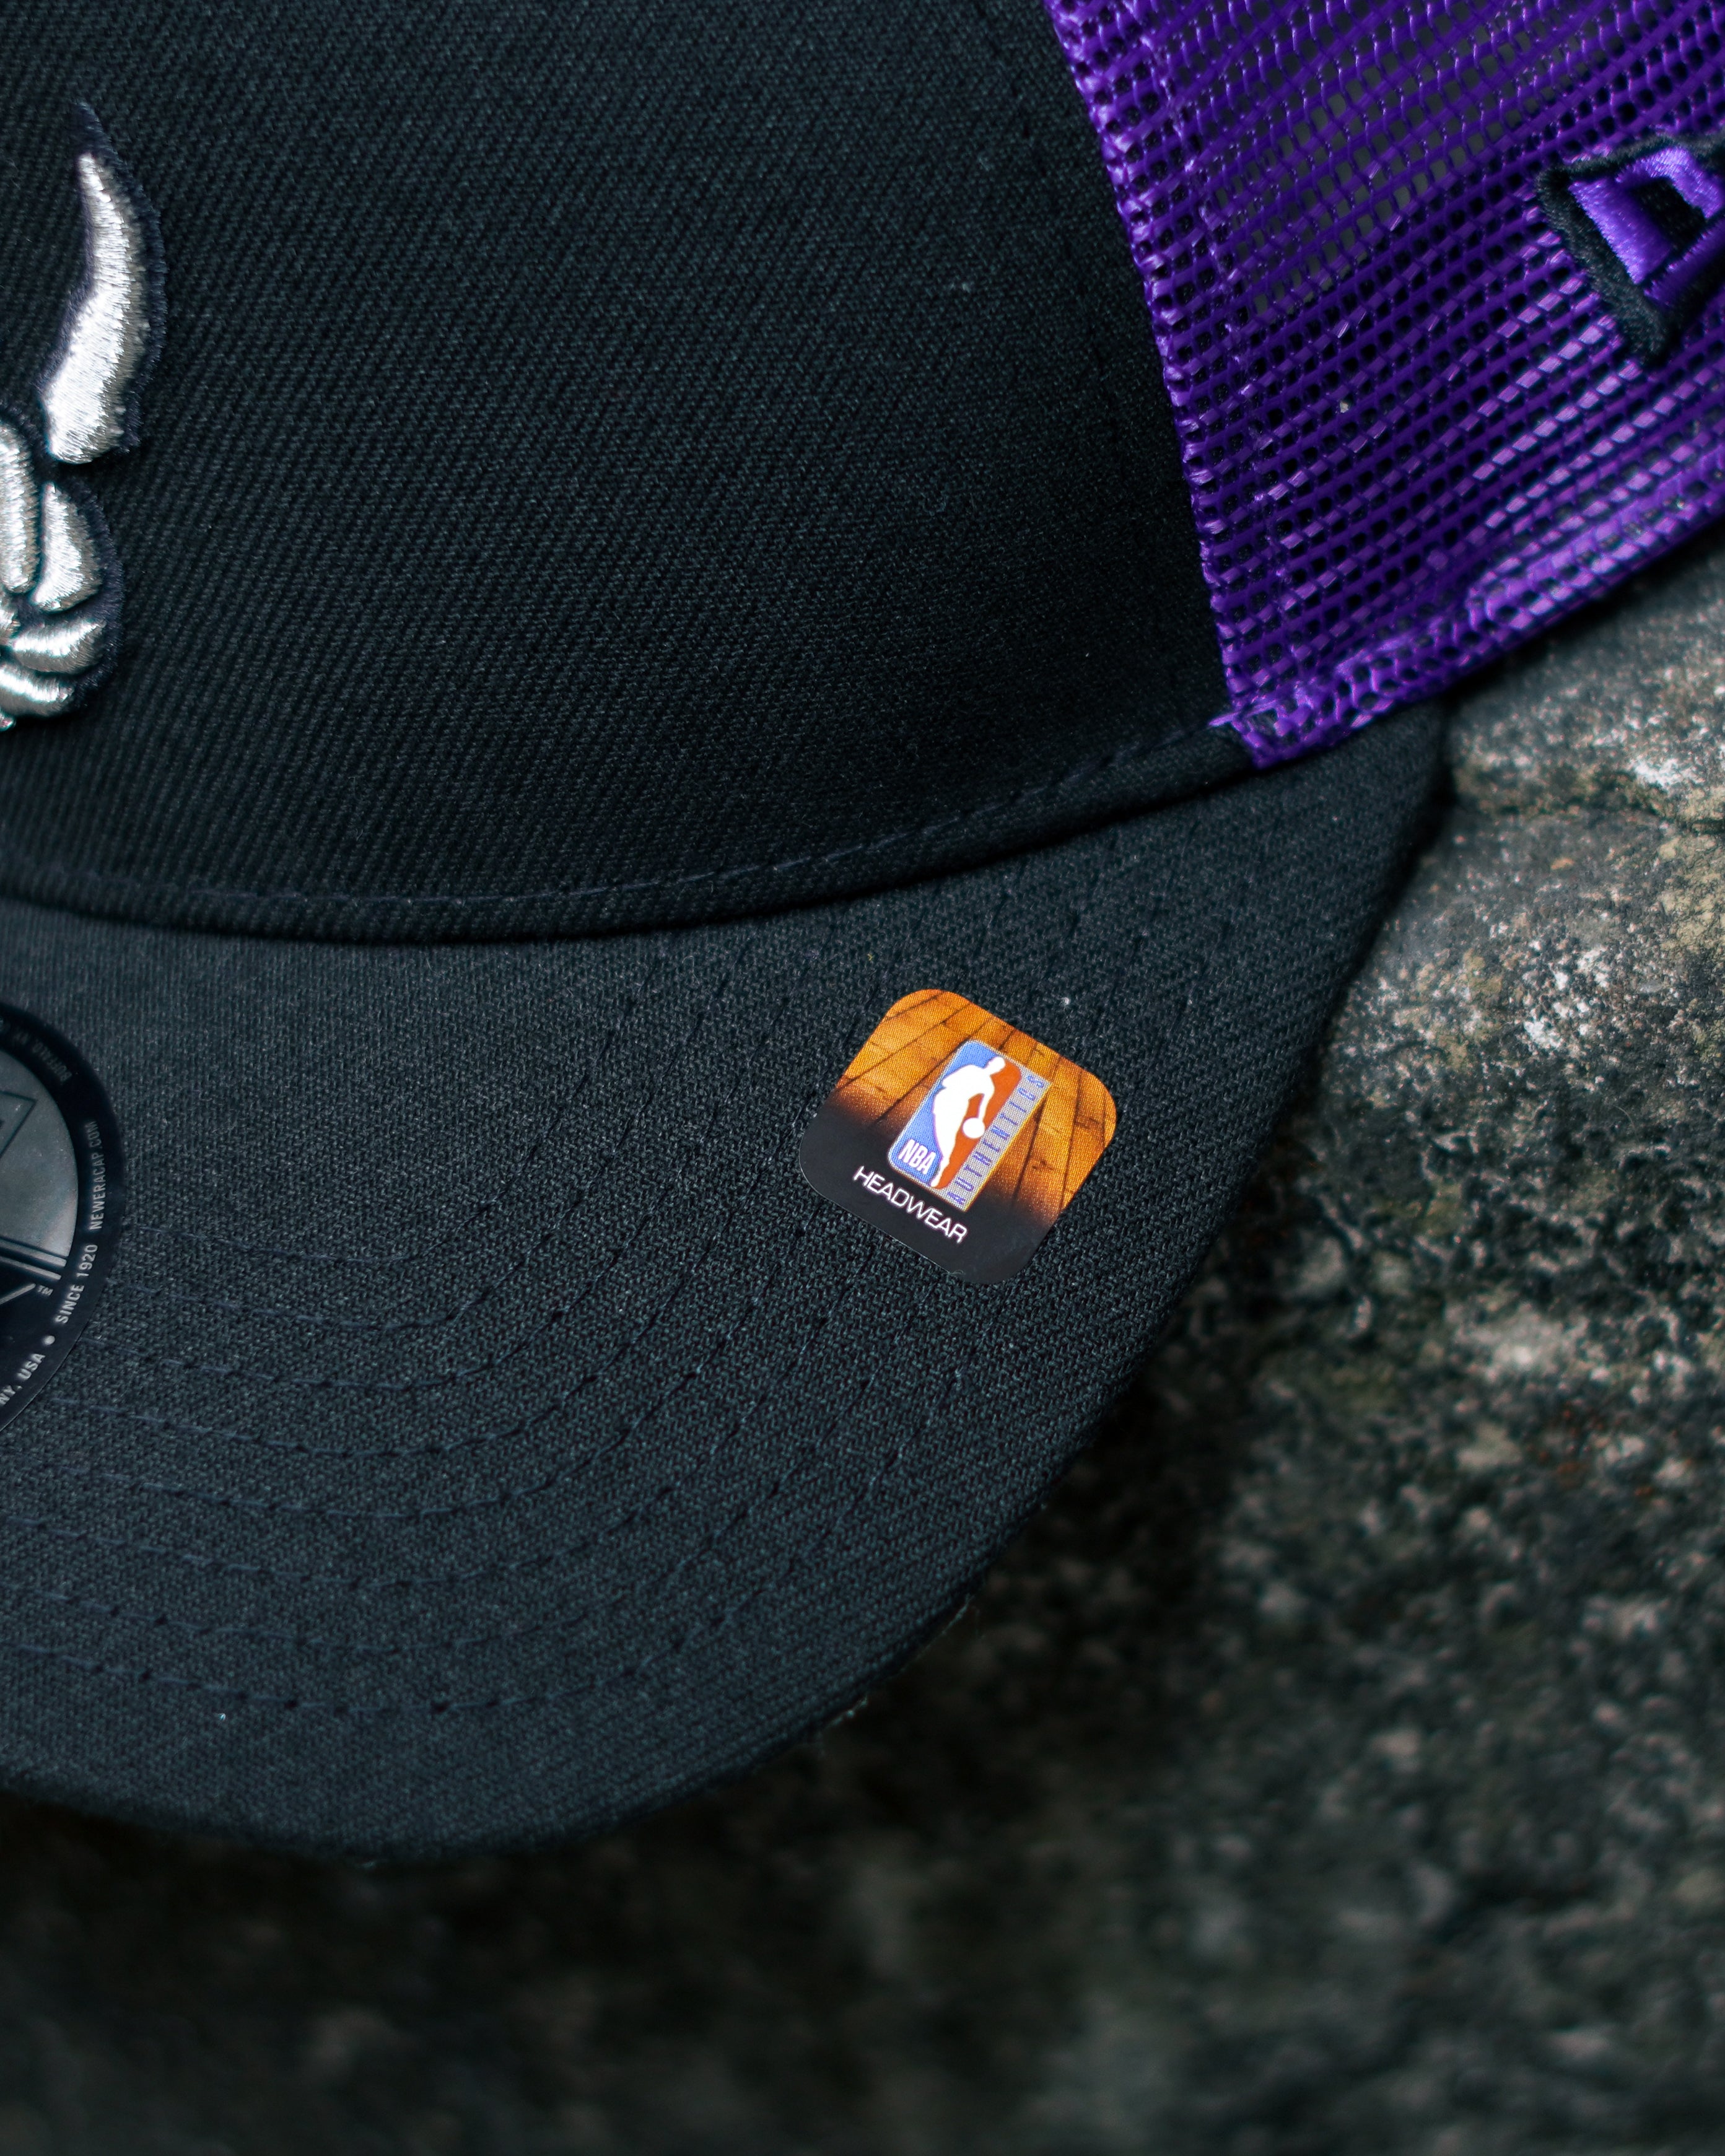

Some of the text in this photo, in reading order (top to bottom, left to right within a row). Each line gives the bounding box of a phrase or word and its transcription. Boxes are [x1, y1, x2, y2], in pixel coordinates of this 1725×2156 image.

[85, 1120, 106, 1230] NEWERACAP.COM
[898, 1139, 937, 1175] NBA
[947, 1074, 1044, 1206] AUTHENTICS
[853, 1166, 967, 1243] HEADWEAR
[55, 1244, 98, 1324] SINCE 1920
[17, 1353, 45, 1380] USA
